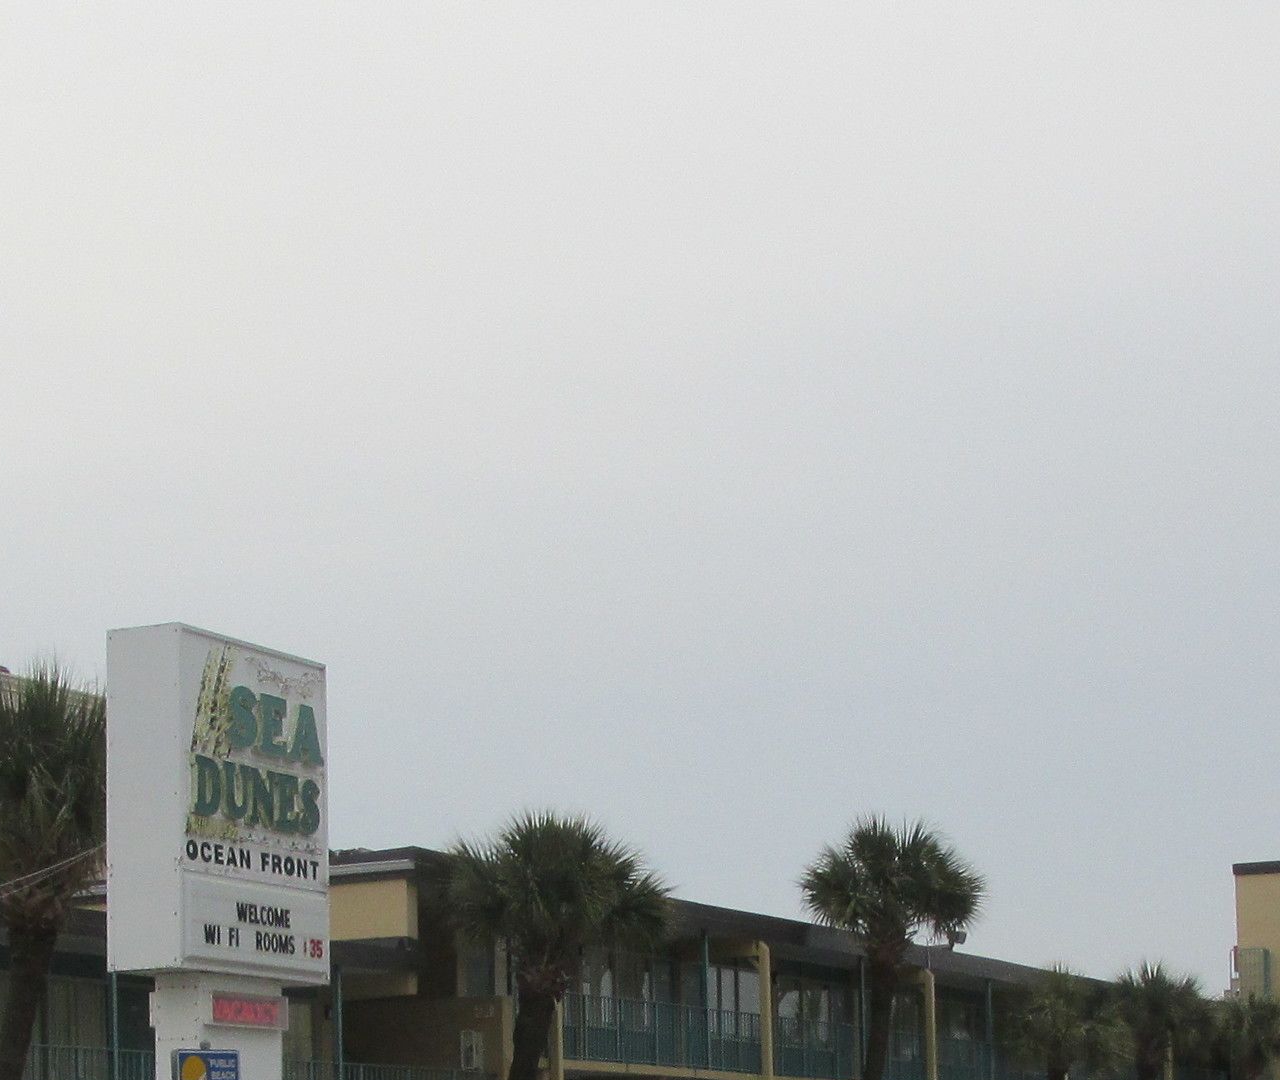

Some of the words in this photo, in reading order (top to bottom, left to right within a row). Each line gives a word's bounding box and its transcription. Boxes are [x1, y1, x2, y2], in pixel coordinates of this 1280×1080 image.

[226, 686, 324, 767] SEA
[191, 754, 320, 836] DUNES
[186, 839, 251, 869] OCEAN
[261, 852, 320, 880] FRONT
[236, 902, 291, 929] WELCOME
[204, 923, 221, 945] WI
[228, 927, 239, 947] FI
[256, 930, 296, 955] ROOMS
